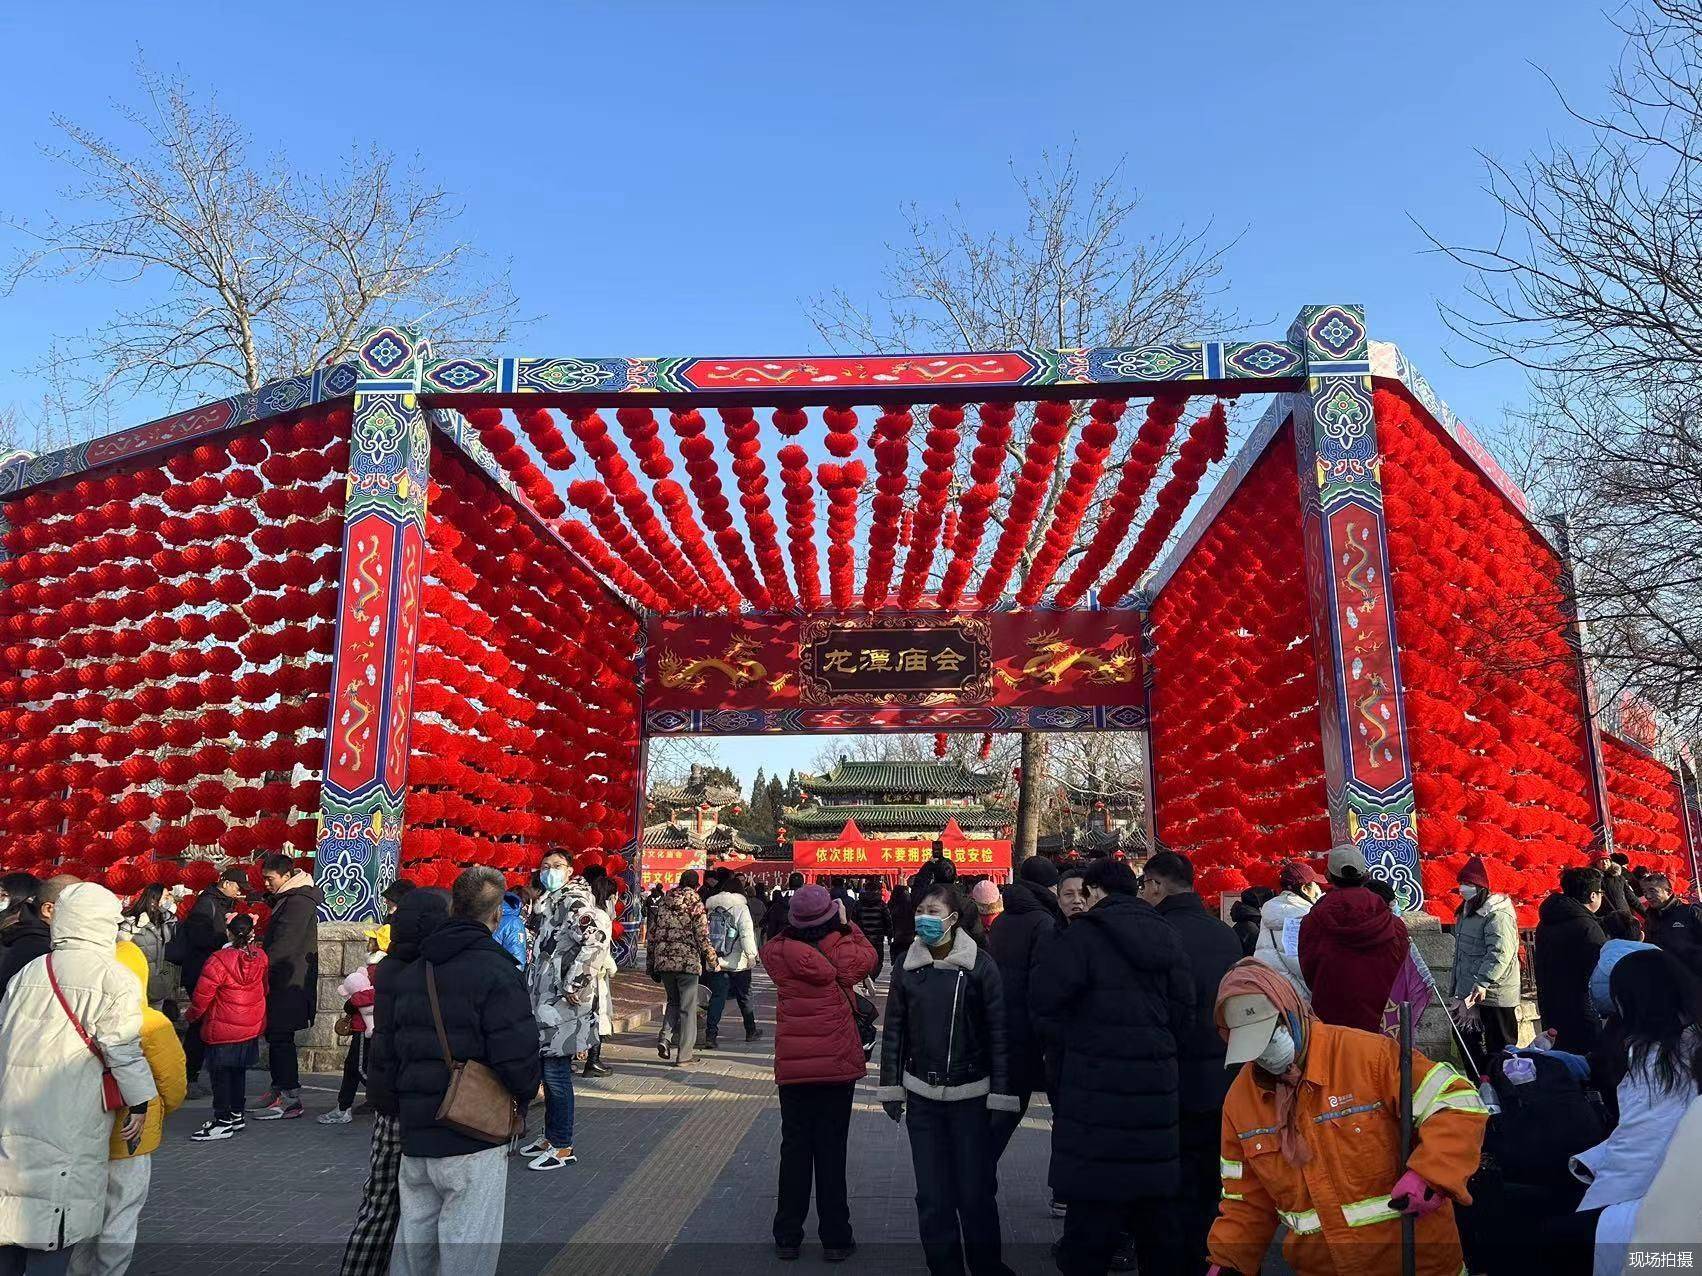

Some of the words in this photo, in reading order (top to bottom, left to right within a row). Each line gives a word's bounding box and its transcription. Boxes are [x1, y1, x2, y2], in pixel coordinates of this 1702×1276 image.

[822, 646, 967, 674] 龙潭庙会
[816, 847, 868, 863] 依次排队
[881, 847, 932, 863] 不要拥挤
